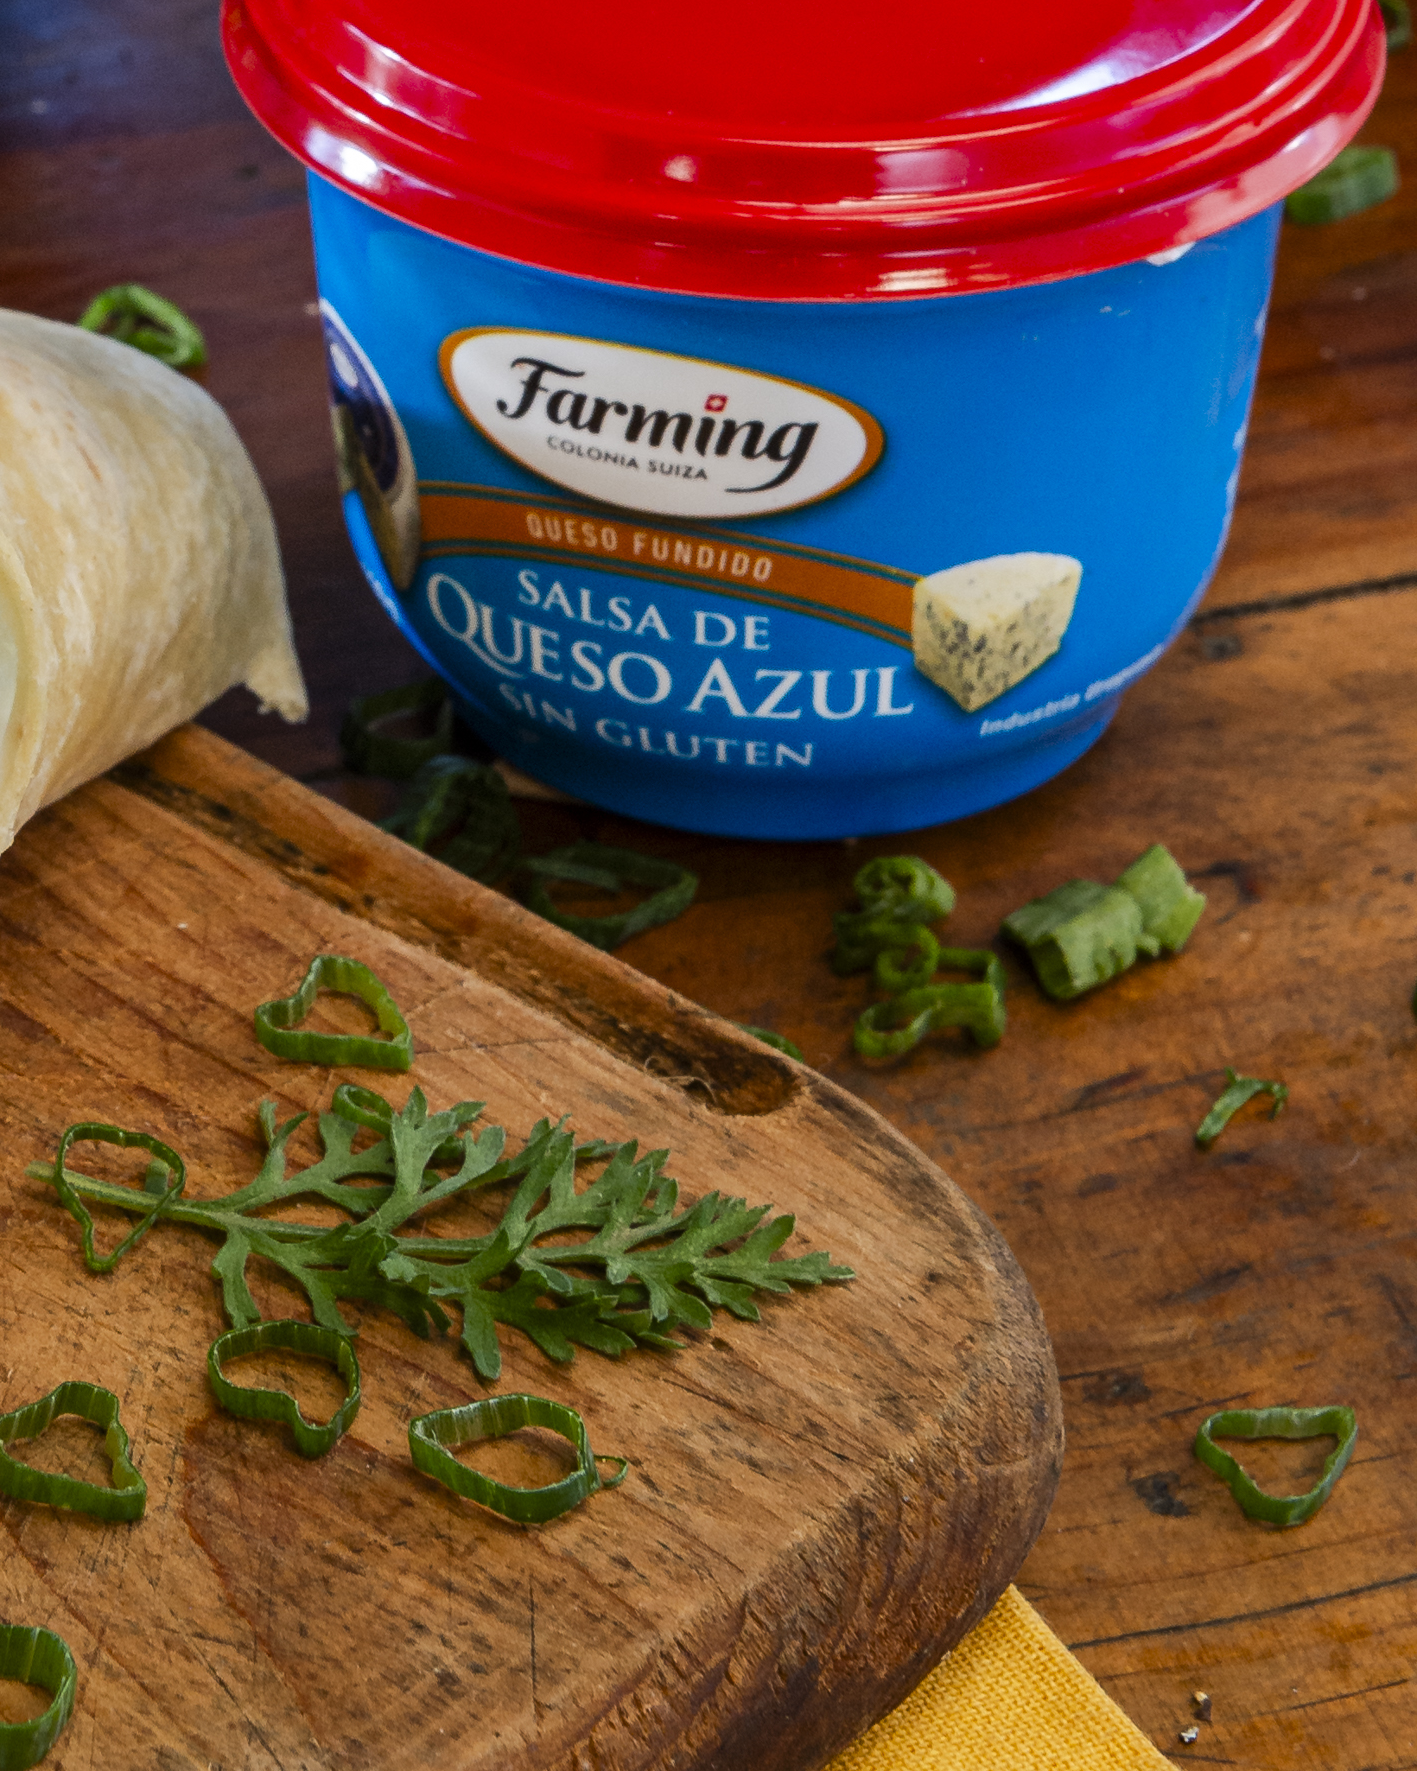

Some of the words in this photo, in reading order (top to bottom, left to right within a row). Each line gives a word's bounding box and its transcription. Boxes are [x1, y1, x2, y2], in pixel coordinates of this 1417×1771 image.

[496, 357, 820, 493] Farming
[546, 434, 638, 471] COLONIA
[648, 459, 709, 482] SUIZA
[526, 512, 618, 553] QUESO
[632, 532, 773, 583] FUNDIDO
[426, 573, 673, 706] QUESO
[686, 657, 915, 721] AZUL
[518, 569, 672, 641] SALSA
[693, 610, 771, 651] DE
[499, 683, 578, 731] SIN
[596, 718, 814, 767] GLUTEN
